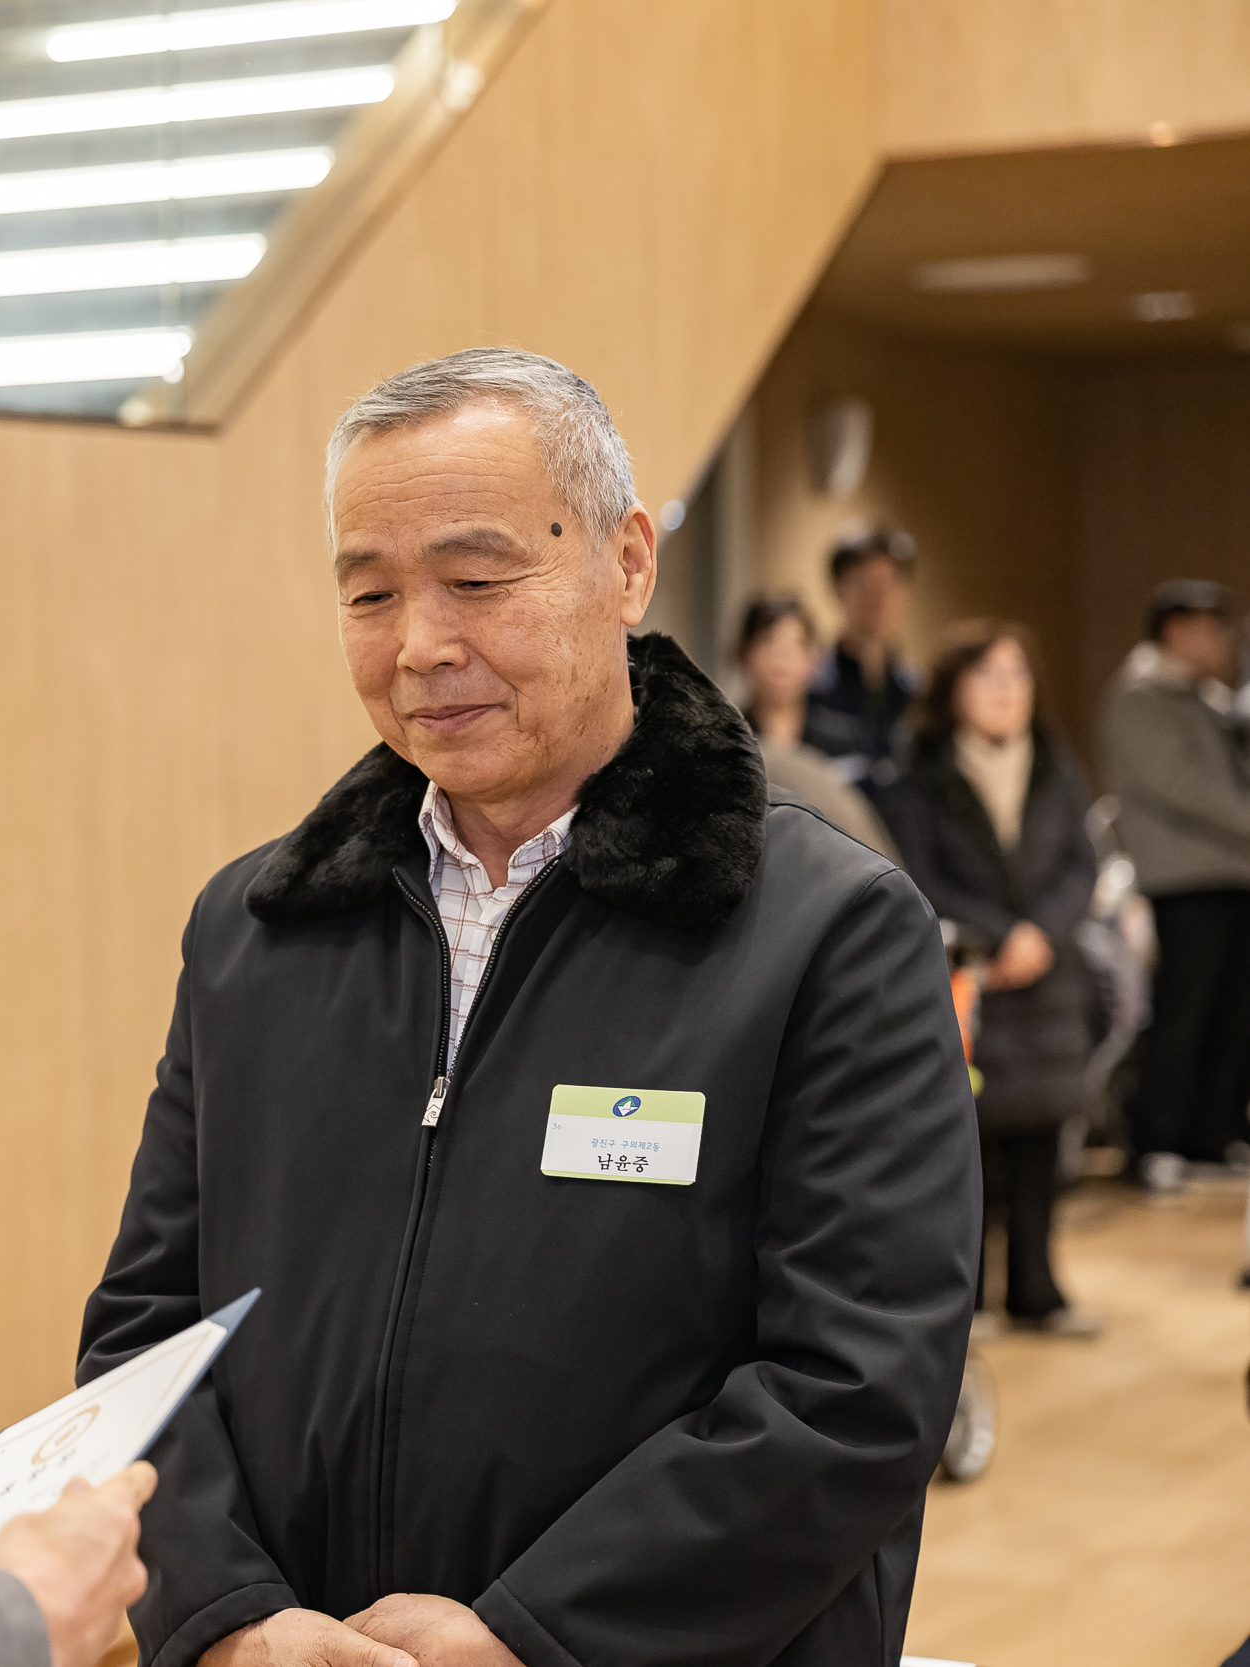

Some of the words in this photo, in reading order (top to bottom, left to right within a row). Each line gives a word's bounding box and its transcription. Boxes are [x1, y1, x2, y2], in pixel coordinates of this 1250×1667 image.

[590, 1138, 616, 1149] 광진구
[621, 1140, 660, 1152] 구의제2동
[597, 1153, 649, 1173] 남윤중
